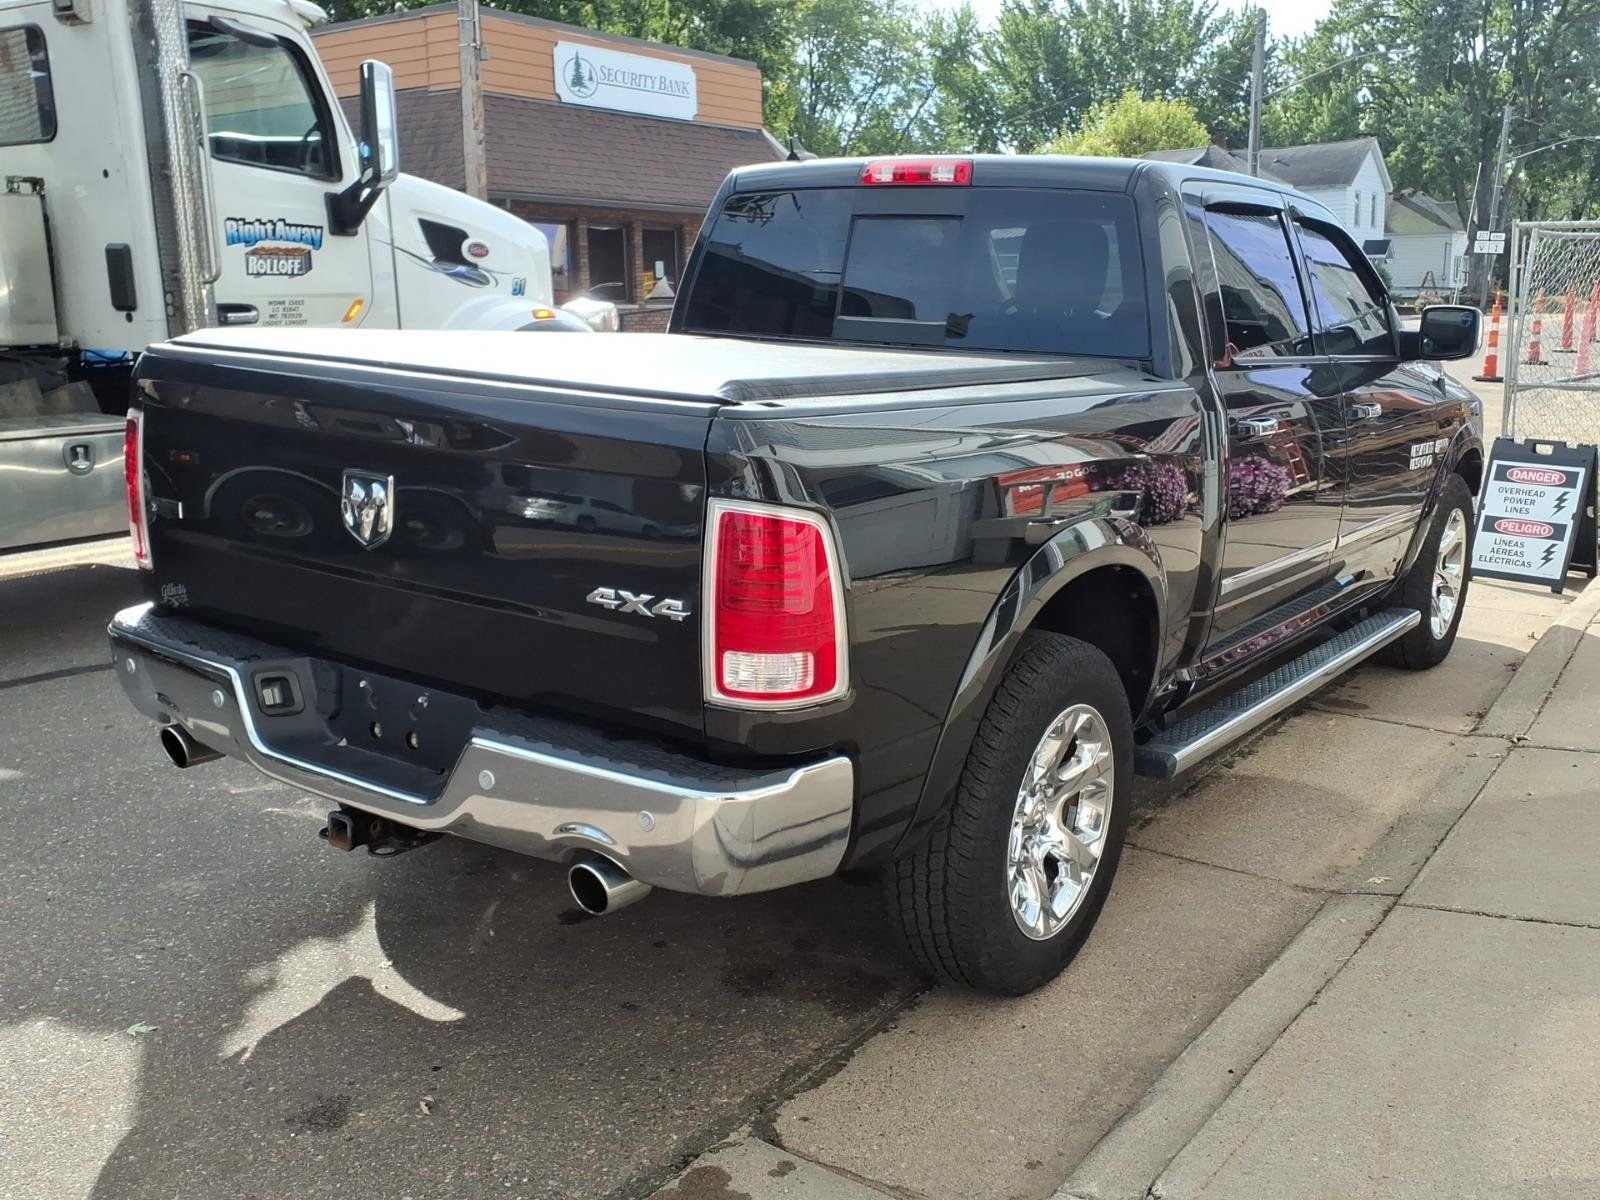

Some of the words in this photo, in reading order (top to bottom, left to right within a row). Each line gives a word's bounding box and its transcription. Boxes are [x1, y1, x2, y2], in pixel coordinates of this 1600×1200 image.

[600, 64, 656, 90] SECURITY
[658, 75, 690, 95] BANK
[247, 255, 302, 274] ROLLOFF
[511, 277, 526, 296] 91
[1512, 470, 1561, 483] DANGER
[1498, 486, 1546, 498] OVERHEAD
[1503, 496, 1536, 506] POWER
[1505, 505, 1530, 515] LINES
[1500, 521, 1549, 535] PELIGRO
